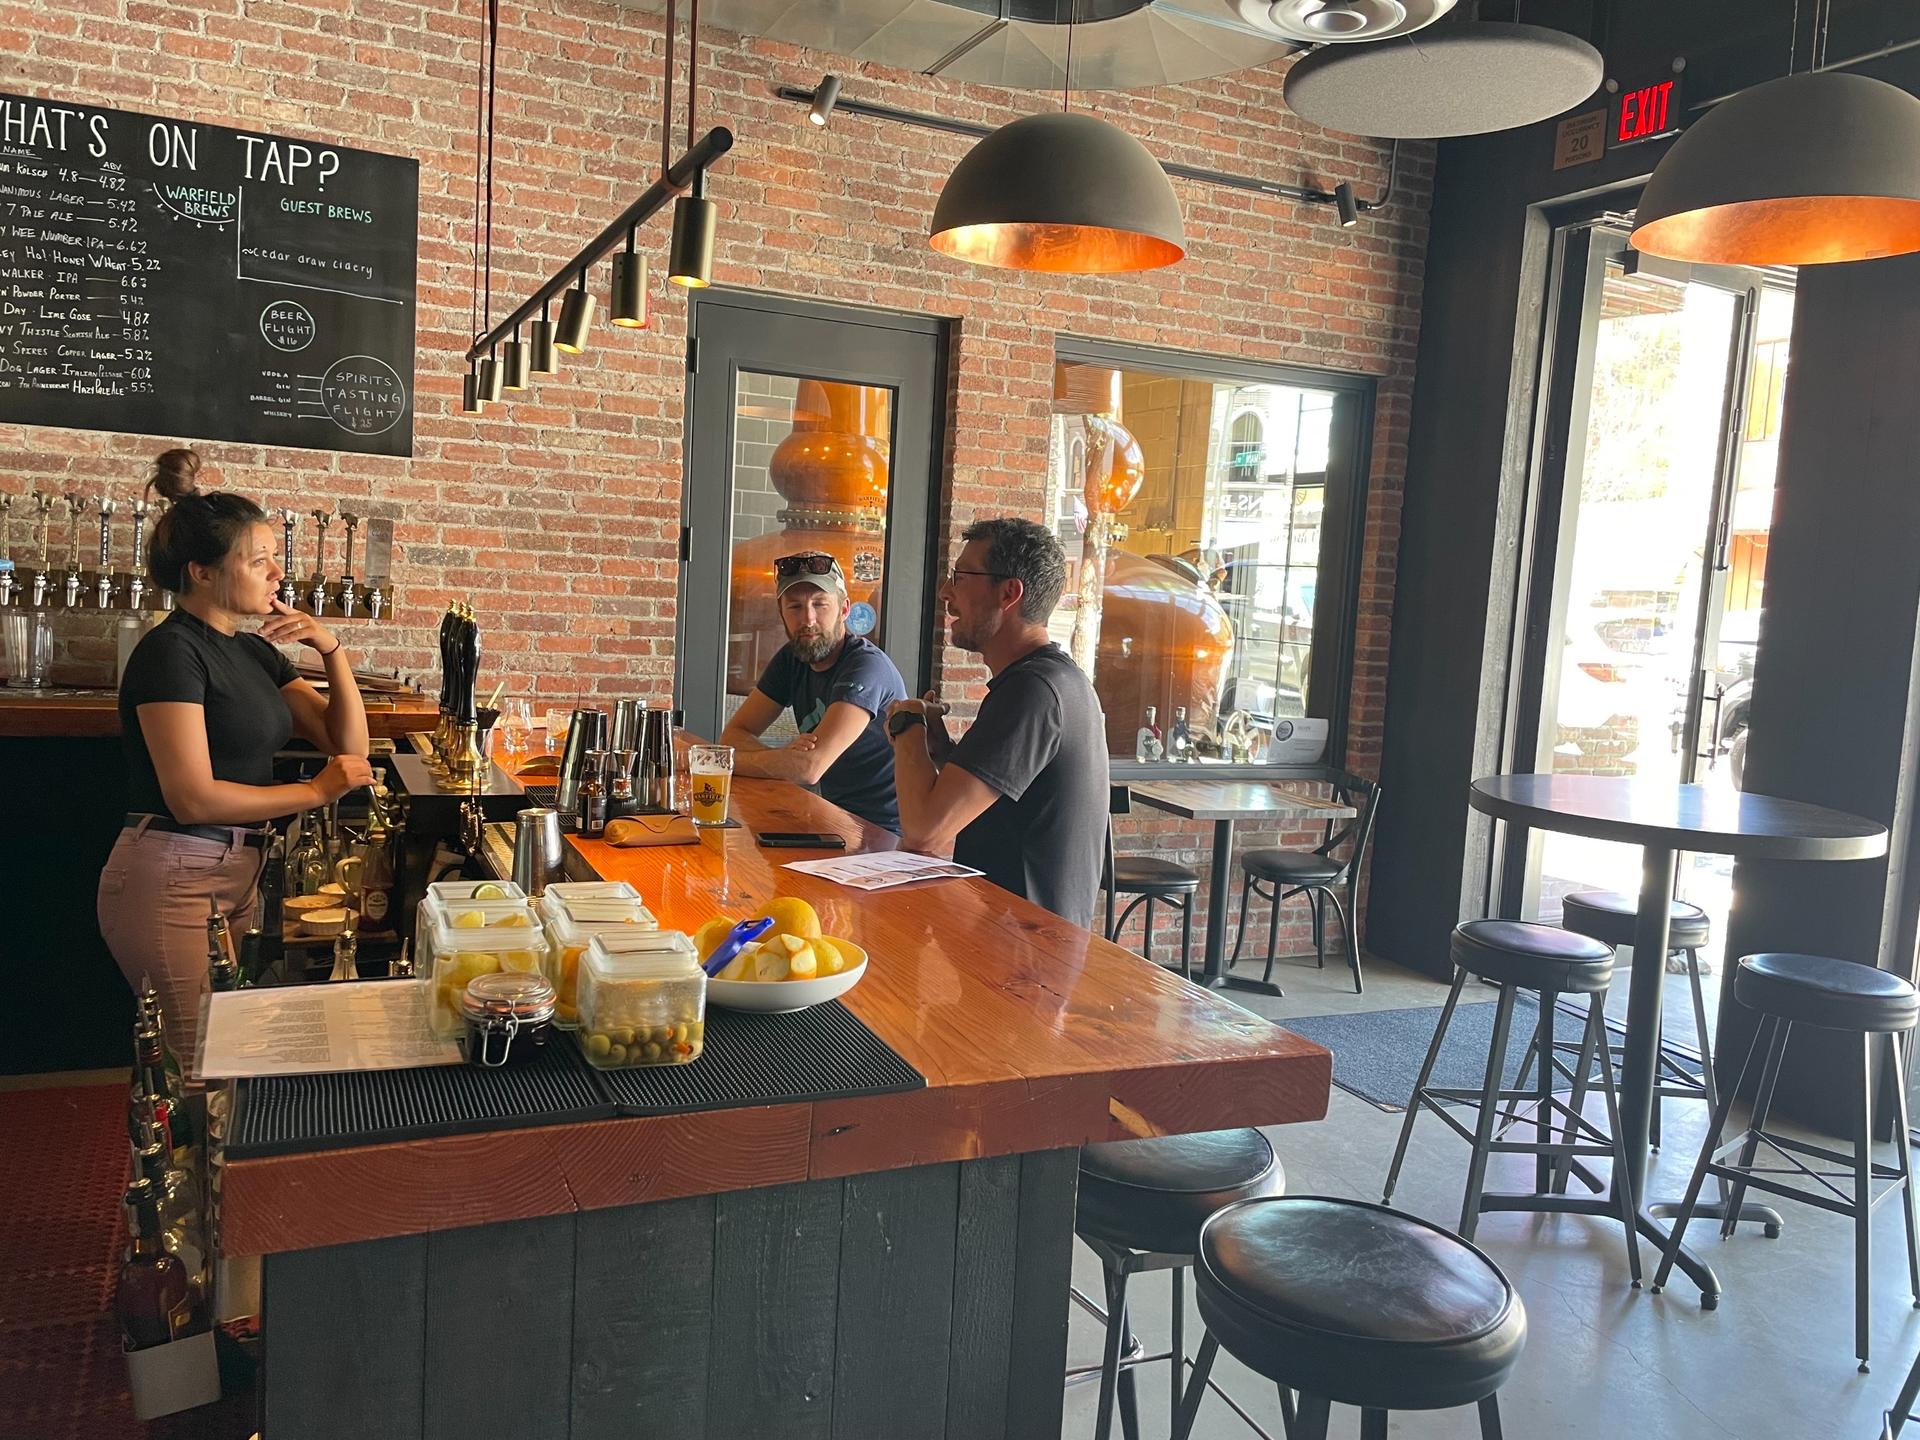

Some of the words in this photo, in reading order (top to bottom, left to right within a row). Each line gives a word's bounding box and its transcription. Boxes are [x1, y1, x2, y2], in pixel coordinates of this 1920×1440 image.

[1618, 81, 1674, 141] EXIT
[2, 145, 36, 156] NAME
[1571, 134, 1588, 152] 20
[149, 122, 197, 171] ON
[236, 135, 340, 192] TAP?
[103, 161, 123, 171] ABV
[50, 190, 85, 206] LAGER
[166, 185, 236, 206] WARFIELD
[20, 205, 45, 218] PALE
[50, 211, 74, 222] ALE
[184, 202, 230, 218] BREWS
[280, 197, 324, 215] GUEST
[328, 205, 372, 224] BREWS
[12, 225, 36, 238] WEE
[53, 250, 85, 267] HONEY
[298, 252, 326, 268] draw
[2, 268, 45, 280] WALKER
[56, 272, 78, 284] IPA
[13, 285, 45, 298] POWDER
[50, 287, 81, 301] PORTER
[4, 303, 26, 316] DAY
[40, 305, 66, 320] LIME
[69, 308, 92, 321] GOSE
[271, 310, 306, 322] BEER
[20, 321, 60, 338] THISTLE
[95, 326, 111, 339] ALE
[264, 323, 311, 335] FLIGHT
[13, 340, 48, 356] SPIRES
[90, 349, 117, 361] LAGER
[0, 358, 22, 373] DOG
[26, 362, 58, 376] LAGER
[61, 363, 97, 378] ITALIAN
[335, 372, 392, 387] SPIRITS
[73, 380, 95, 396] HAZY
[325, 387, 401, 404] TASTING
[333, 404, 397, 419] FLIGHT
